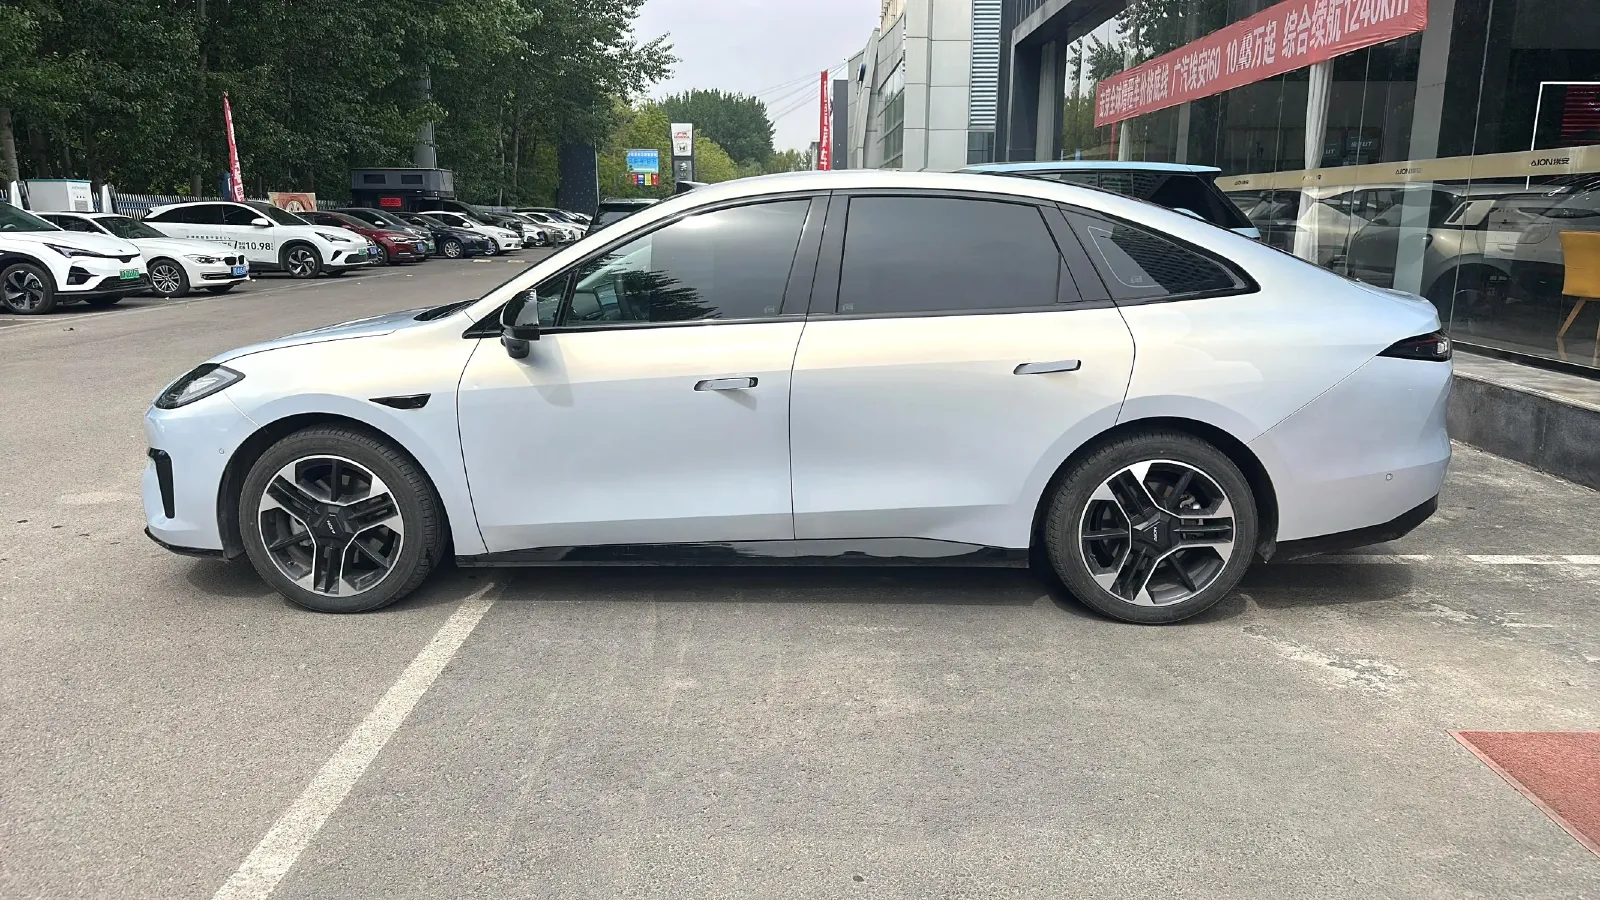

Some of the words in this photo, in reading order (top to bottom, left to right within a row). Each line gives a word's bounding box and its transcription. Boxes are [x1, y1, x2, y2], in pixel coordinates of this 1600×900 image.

[1171, 46, 1221, 96] 广汽埃安i60
[245, 241, 271, 251] 10.98
